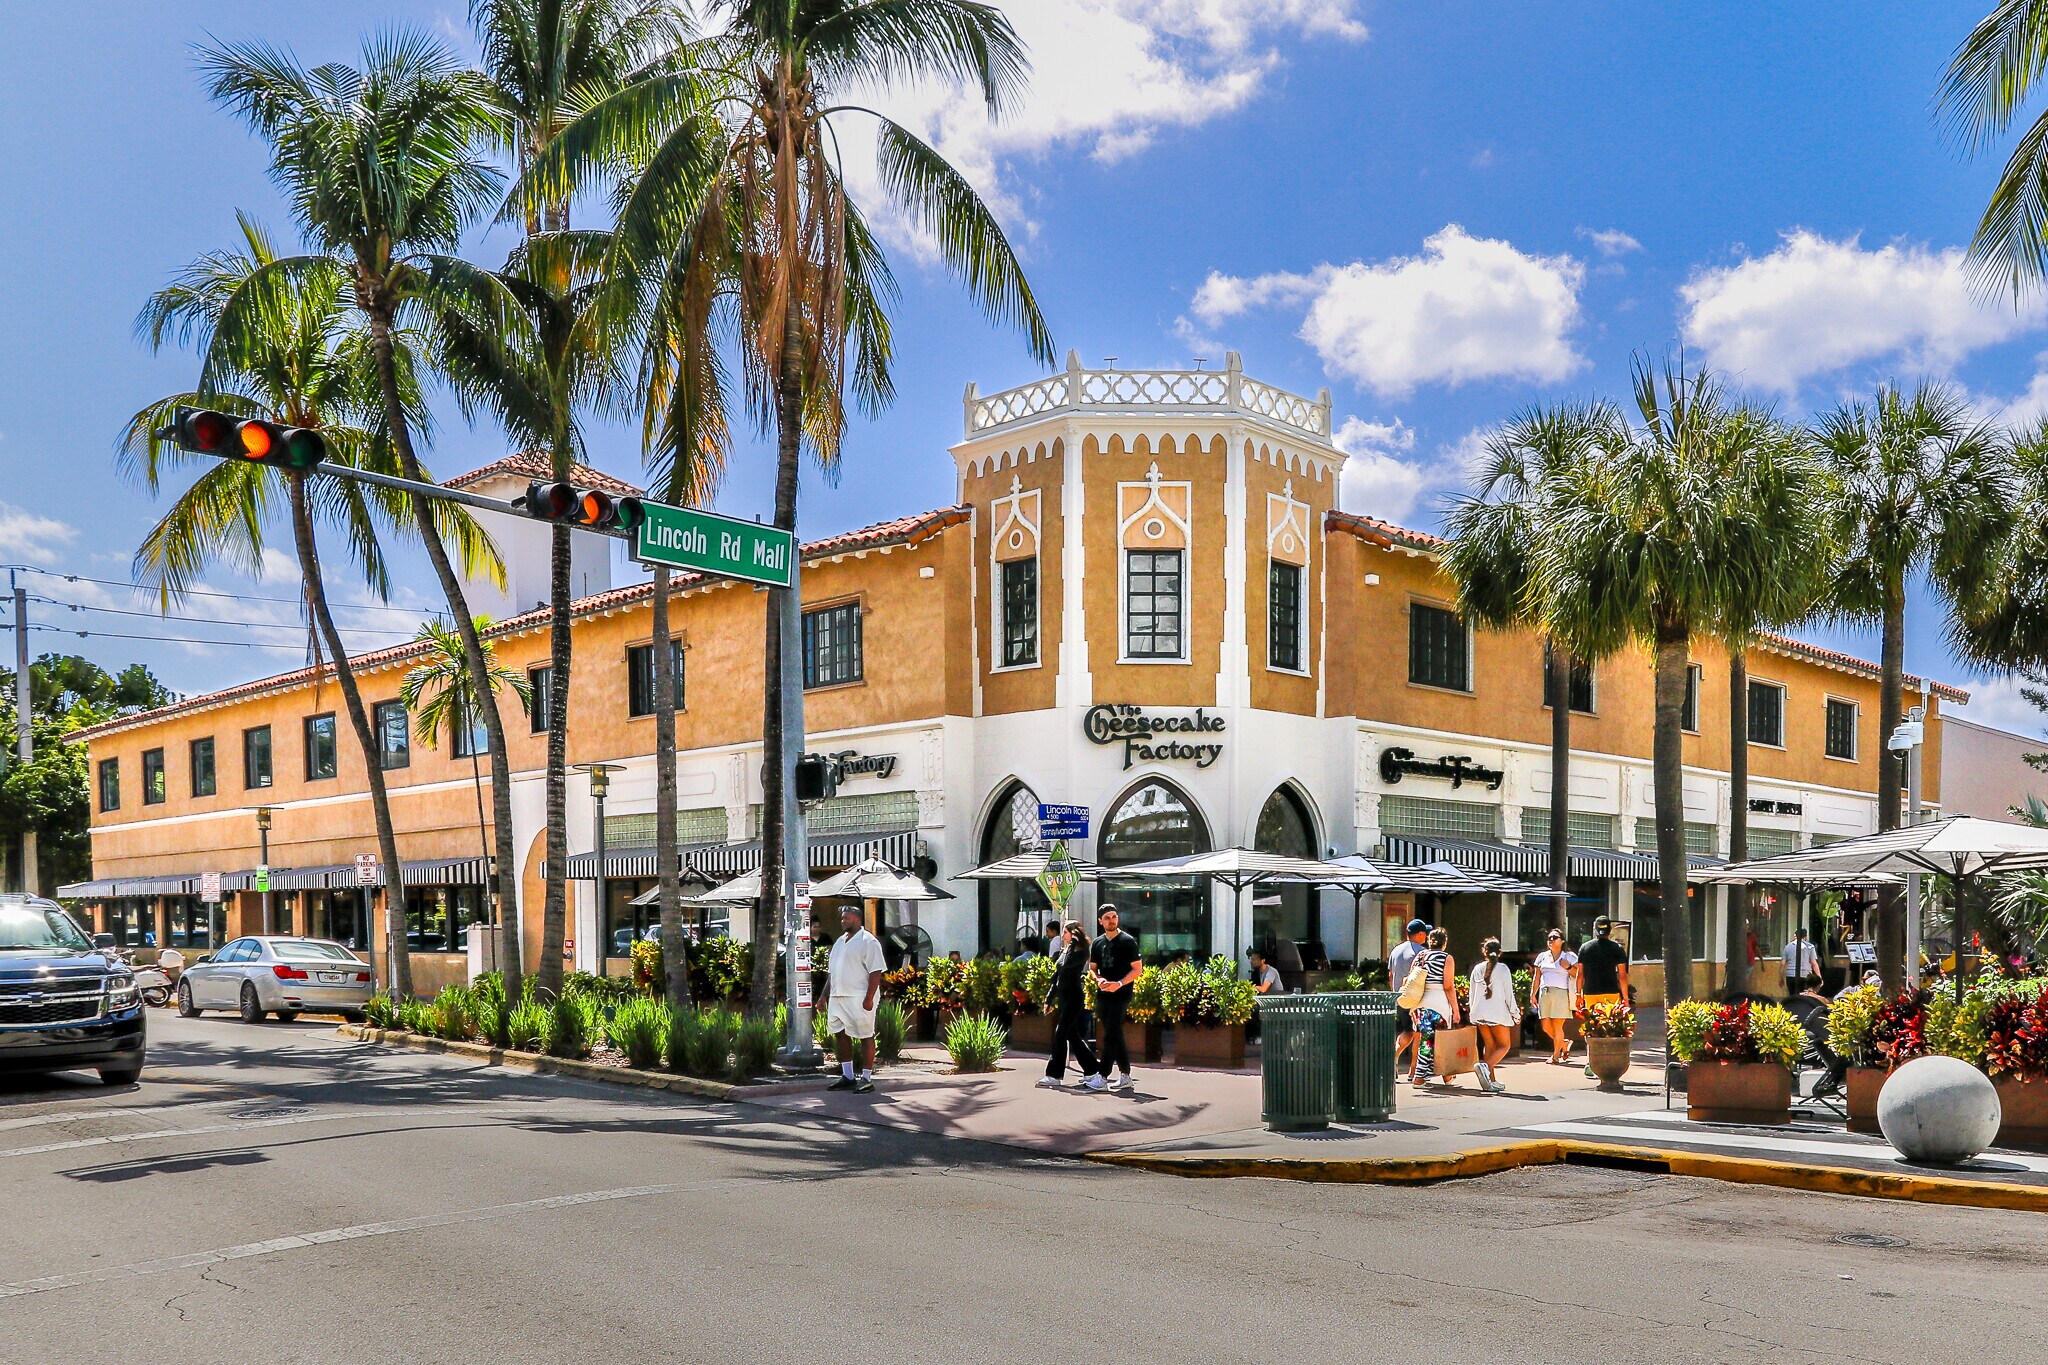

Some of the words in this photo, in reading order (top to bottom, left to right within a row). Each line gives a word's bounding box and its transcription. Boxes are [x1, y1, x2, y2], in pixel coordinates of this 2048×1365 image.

[646, 516, 708, 555] Lincoln
[719, 531, 741, 562] Rd
[753, 538, 785, 571] Mall
[1083, 704, 1226, 745] Cheesecake
[1117, 703, 1142, 717] The
[829, 750, 897, 786] Factory
[1110, 732, 1224, 771] Factory
[1046, 805, 1072, 815] Lincoln
[1073, 806, 1089, 816] Road
